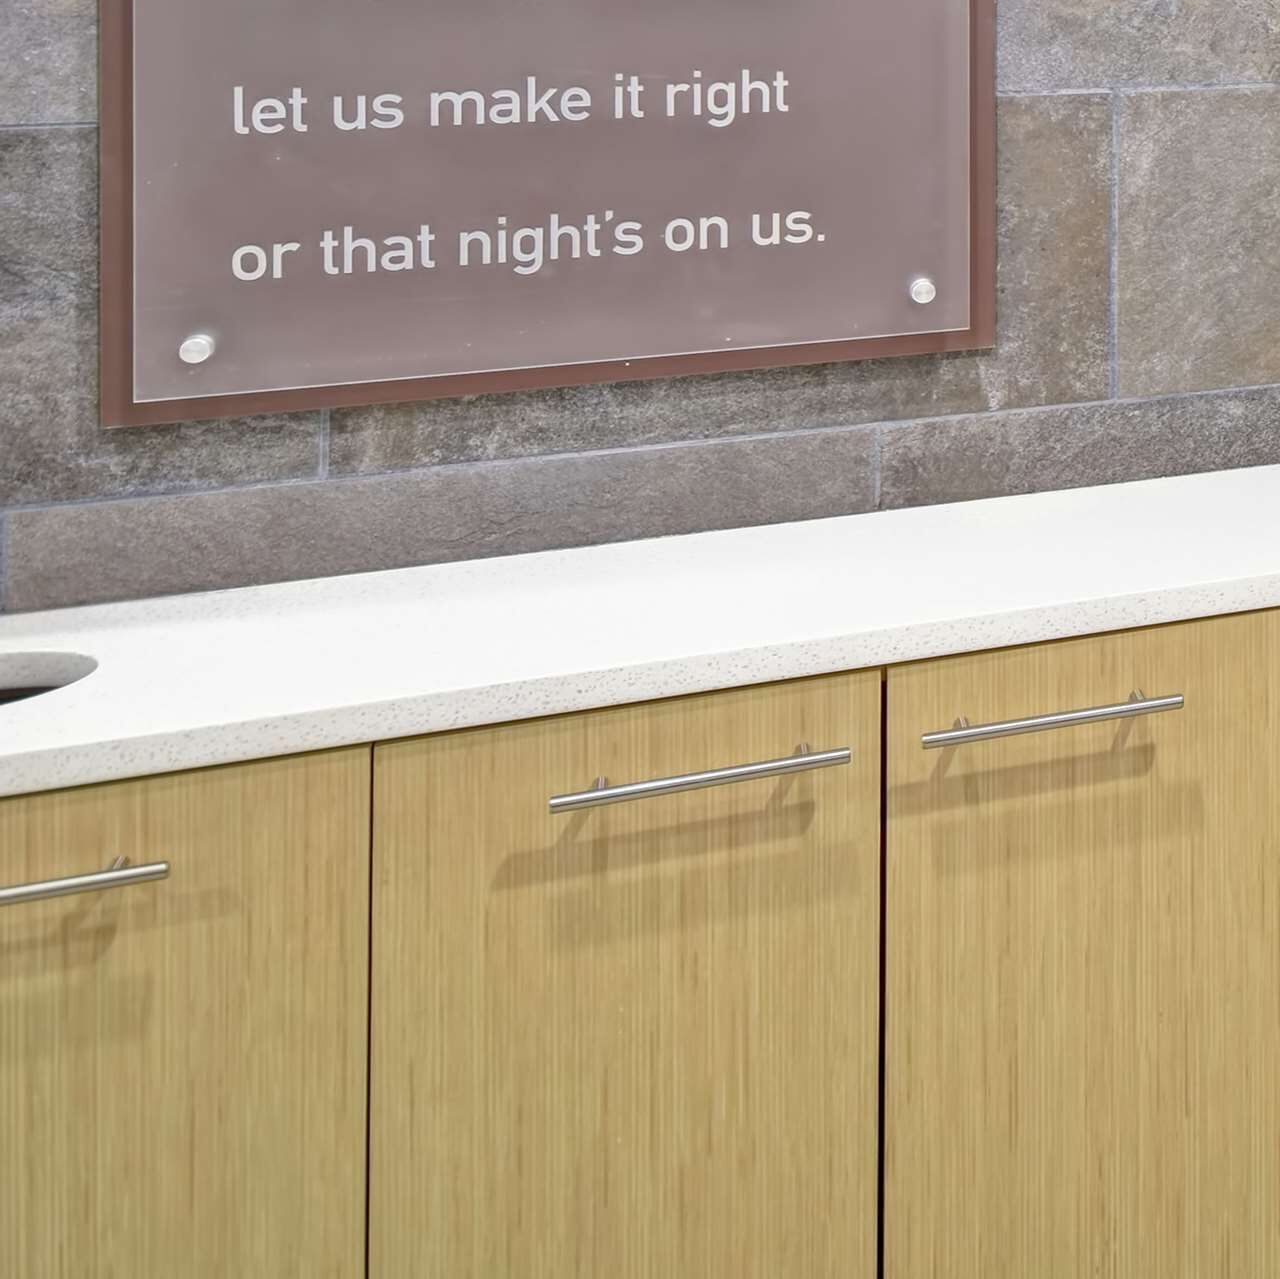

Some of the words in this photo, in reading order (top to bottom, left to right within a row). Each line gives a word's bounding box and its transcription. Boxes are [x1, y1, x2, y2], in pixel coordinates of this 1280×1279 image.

[232, 84, 309, 136] let
[332, 92, 405, 131] us
[429, 75, 593, 128] make
[613, 72, 645, 120] it
[666, 67, 790, 128] right
[230, 242, 302, 282] or
[319, 223, 437, 276] that
[458, 209, 645, 276] night's
[663, 215, 730, 253] on
[751, 206, 827, 247] us.
